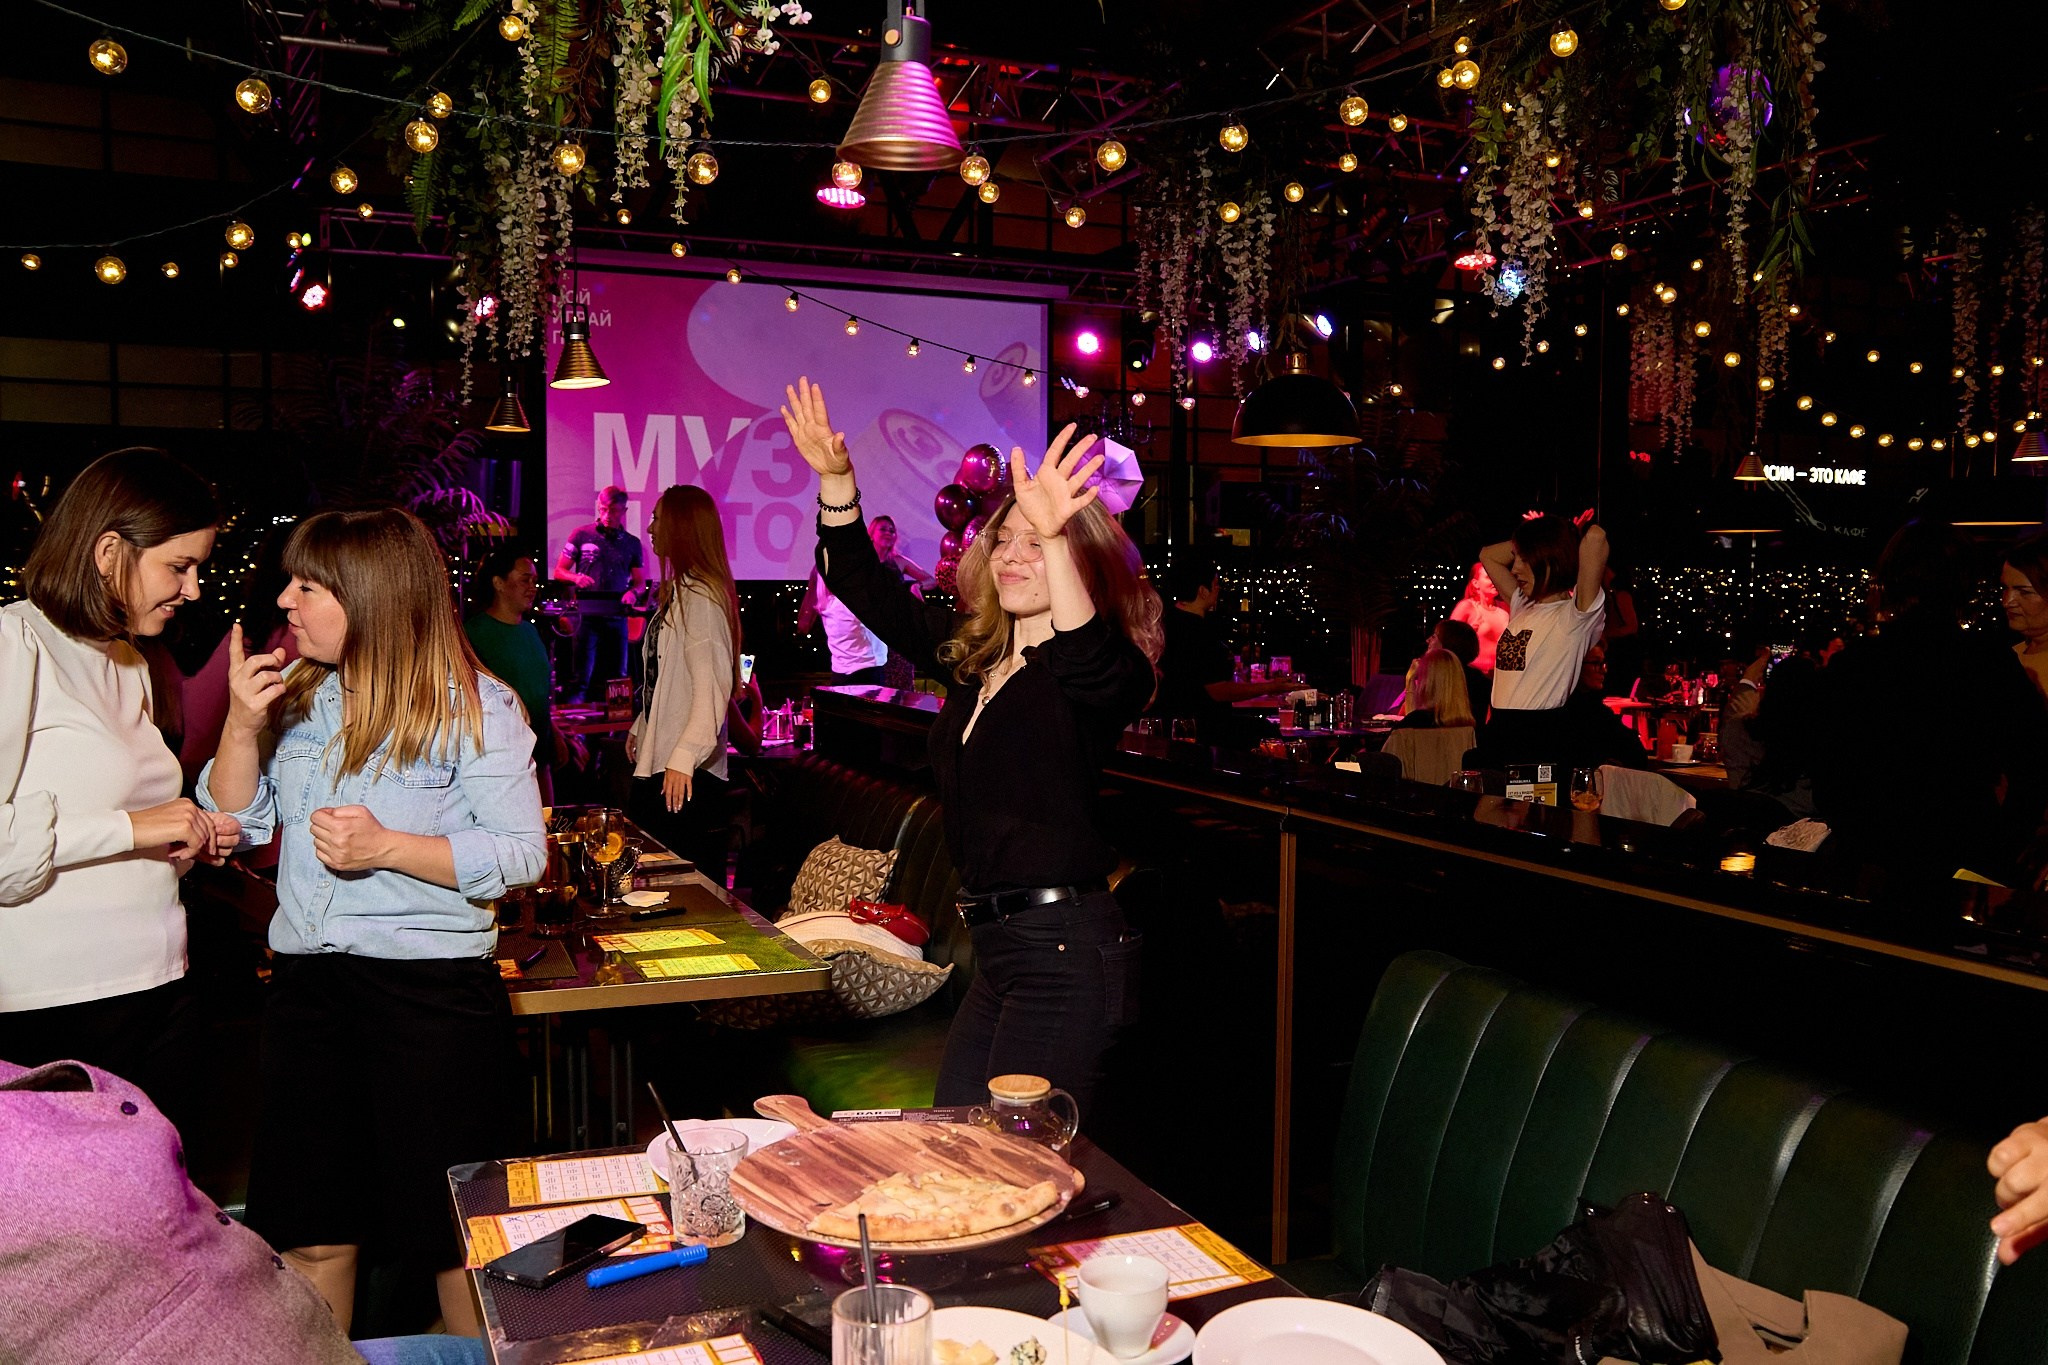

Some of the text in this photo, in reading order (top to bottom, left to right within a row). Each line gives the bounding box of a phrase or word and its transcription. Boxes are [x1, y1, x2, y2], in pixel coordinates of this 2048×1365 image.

[593, 412, 812, 500] МУЗ
[1809, 466, 1834, 484] ЭТО
[1834, 468, 1867, 486] КАФЕ
